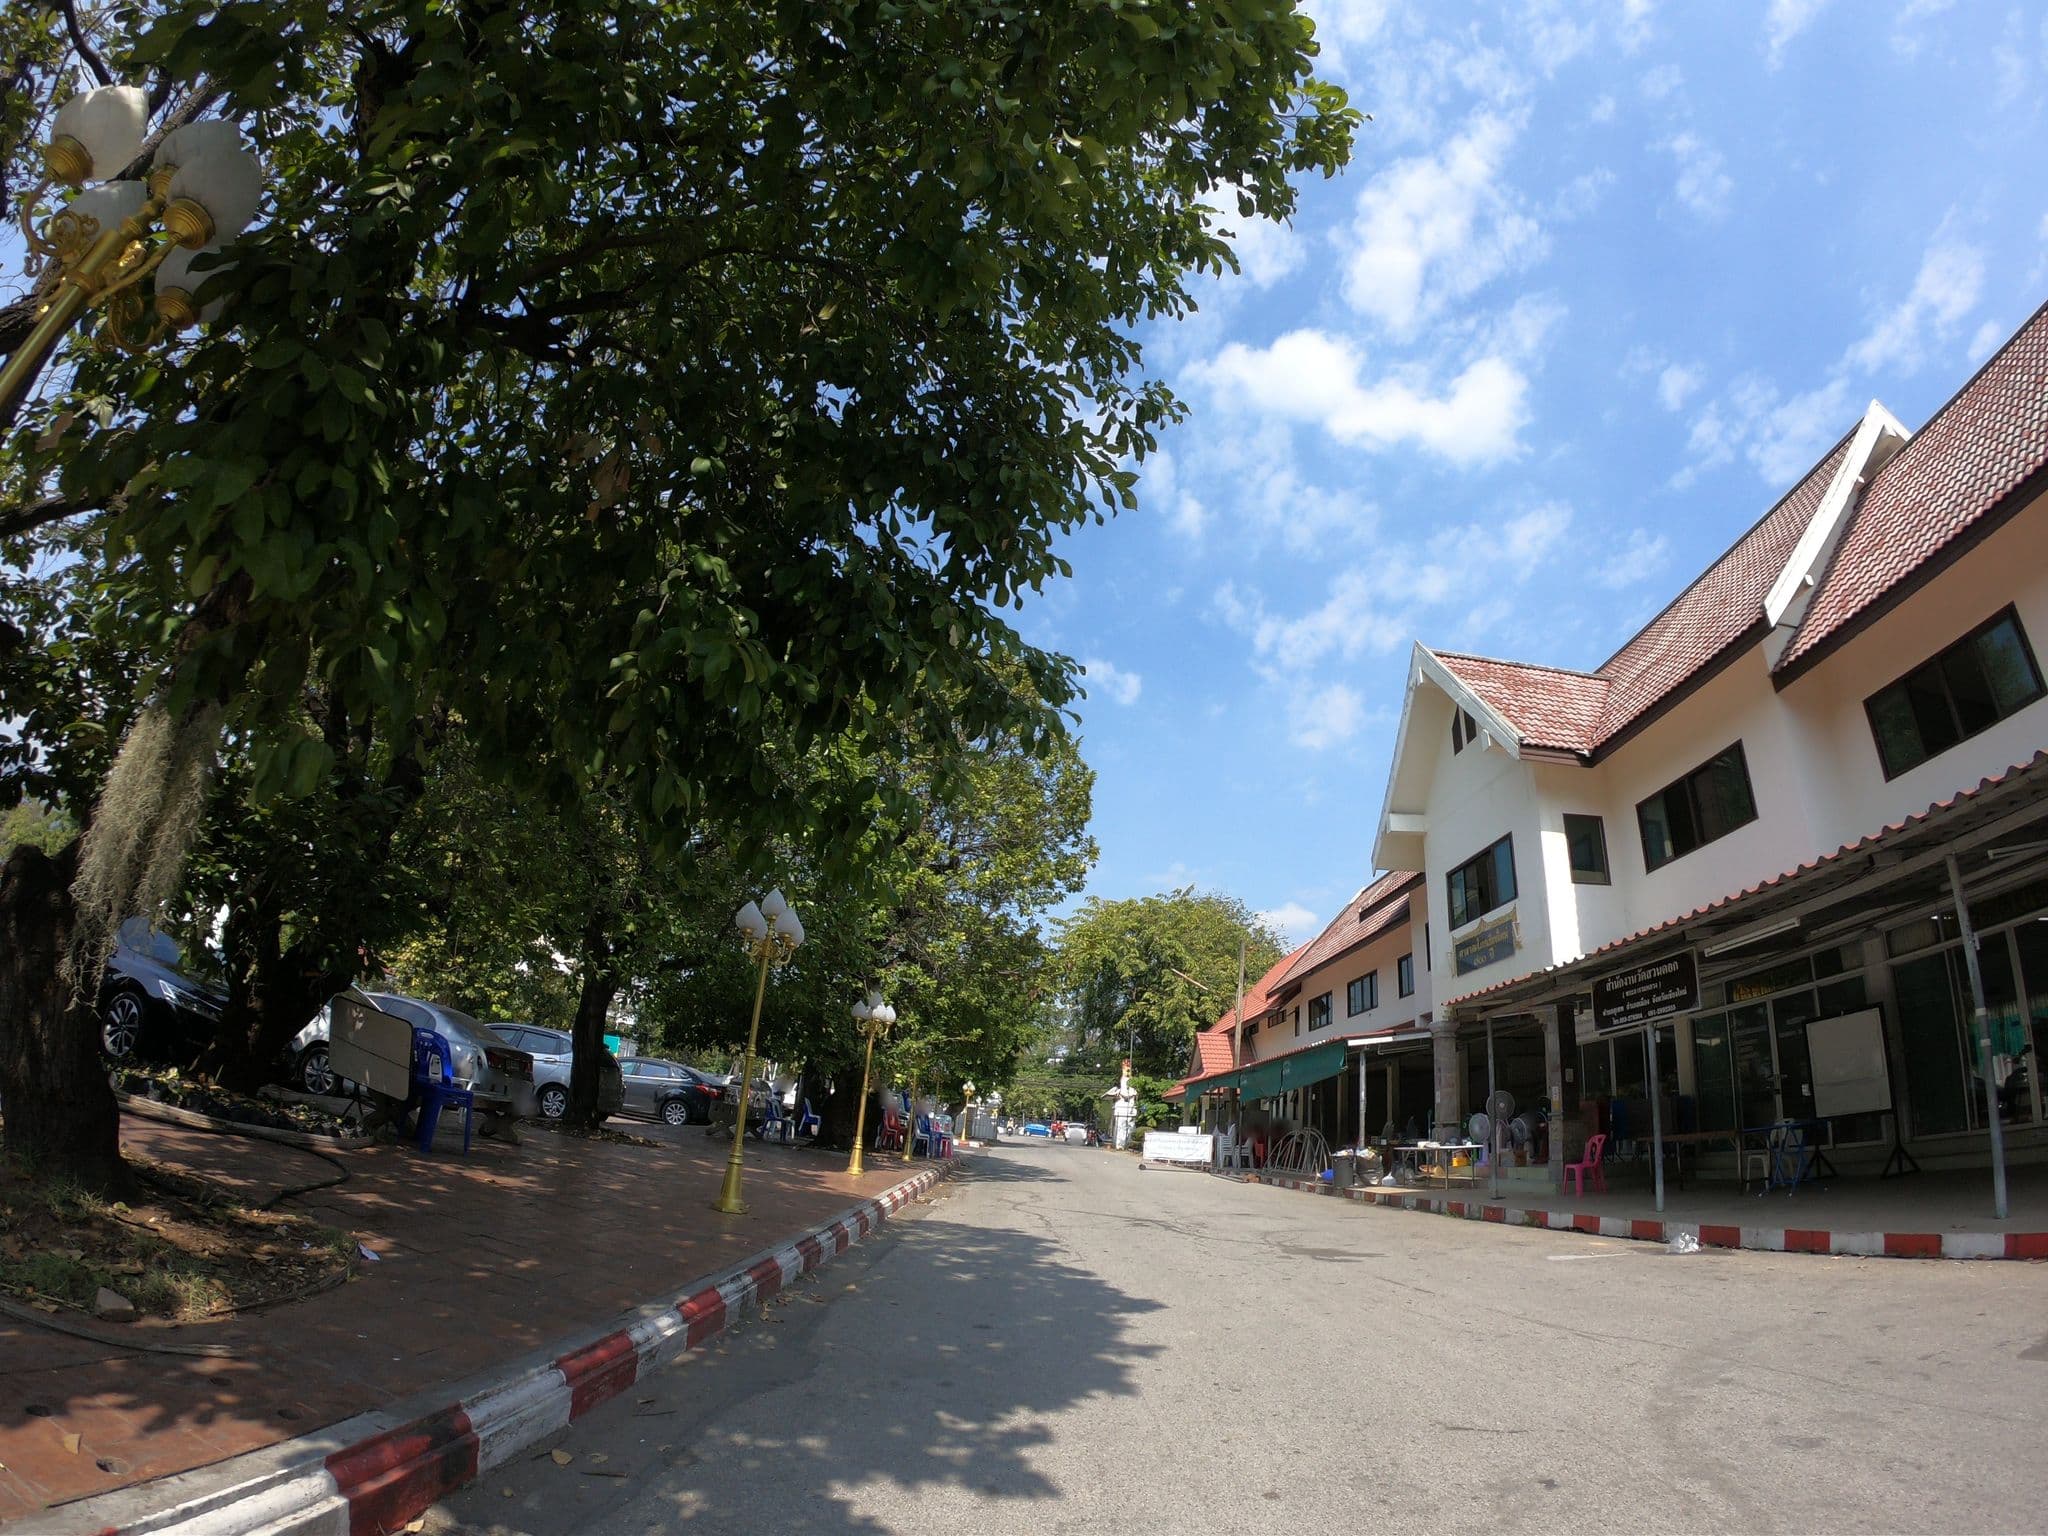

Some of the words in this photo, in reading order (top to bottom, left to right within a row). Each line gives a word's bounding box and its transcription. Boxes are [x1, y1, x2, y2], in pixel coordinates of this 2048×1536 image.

[1606, 961, 1679, 991] สำนักงานวัดสวนดอก
